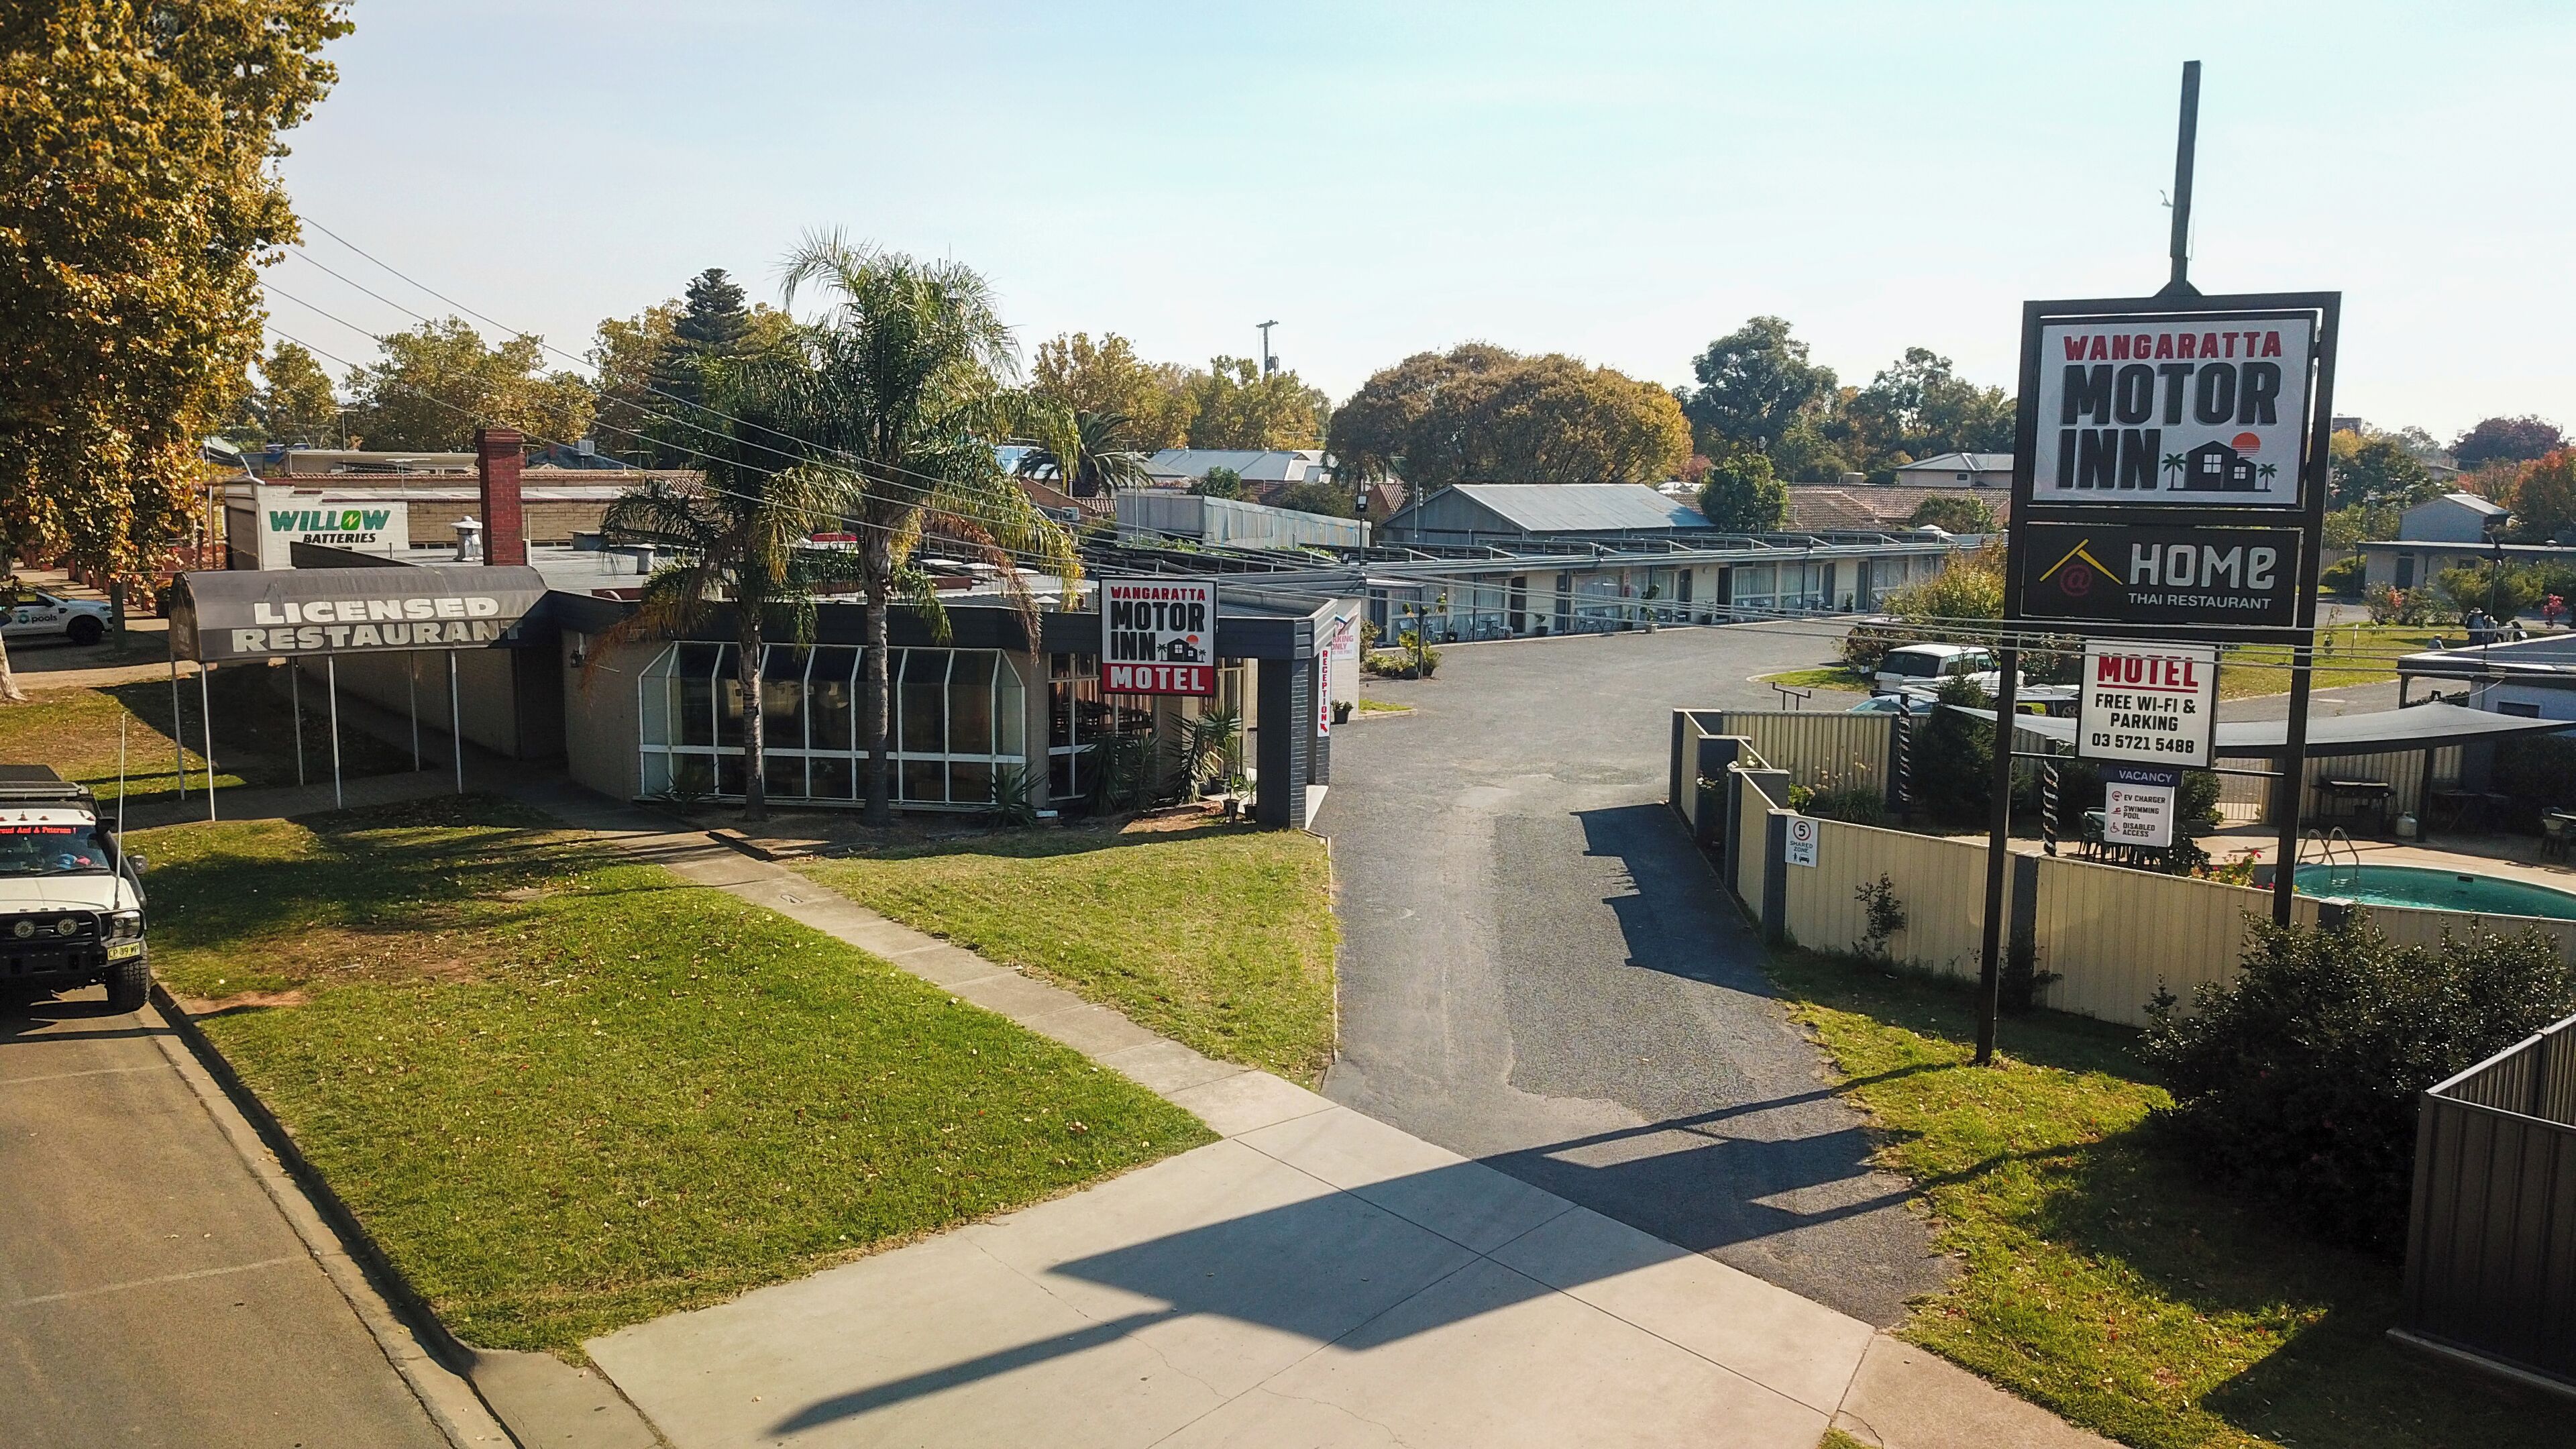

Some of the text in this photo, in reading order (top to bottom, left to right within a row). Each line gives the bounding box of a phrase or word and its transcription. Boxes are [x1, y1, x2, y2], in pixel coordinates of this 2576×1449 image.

[2063, 331, 2282, 361] WANGARATTA
[2059, 362, 2282, 427] MOTOR
[2055, 429, 2161, 490] INN
[269, 510, 390, 531] WILLOW
[303, 533, 376, 543] BATTERIES
[1110, 586, 1205, 600] WANGARATTA
[2128, 592, 2271, 609] THAI RESTAURANT
[31, 614, 58, 624] pools
[254, 598, 499, 624] LICENSED
[1110, 600, 1205, 632] MOTOR
[231, 621, 522, 652] RESTAURANT
[1111, 631, 1156, 661] INN
[1110, 666, 1205, 691] MOTEL
[2098, 652, 2198, 687] MOTEL
[1318, 650, 1328, 722] RECEPTION
[2095, 693, 2196, 714] FREE WI-FI &
[2110, 712, 2178, 731] PARKING
[2092, 733, 2194, 753] 03 5721 5488
[2118, 769, 2172, 783] VACANCY
[2134, 795, 2166, 804] CHARGER
[2123, 806, 2159, 814] SWIMMING
[1799, 824, 1806, 837] 5
[2122, 829, 2149, 837] ACCESS
[2123, 822, 2155, 831] DISABLED
[1790, 840, 1813, 849] SHARED
